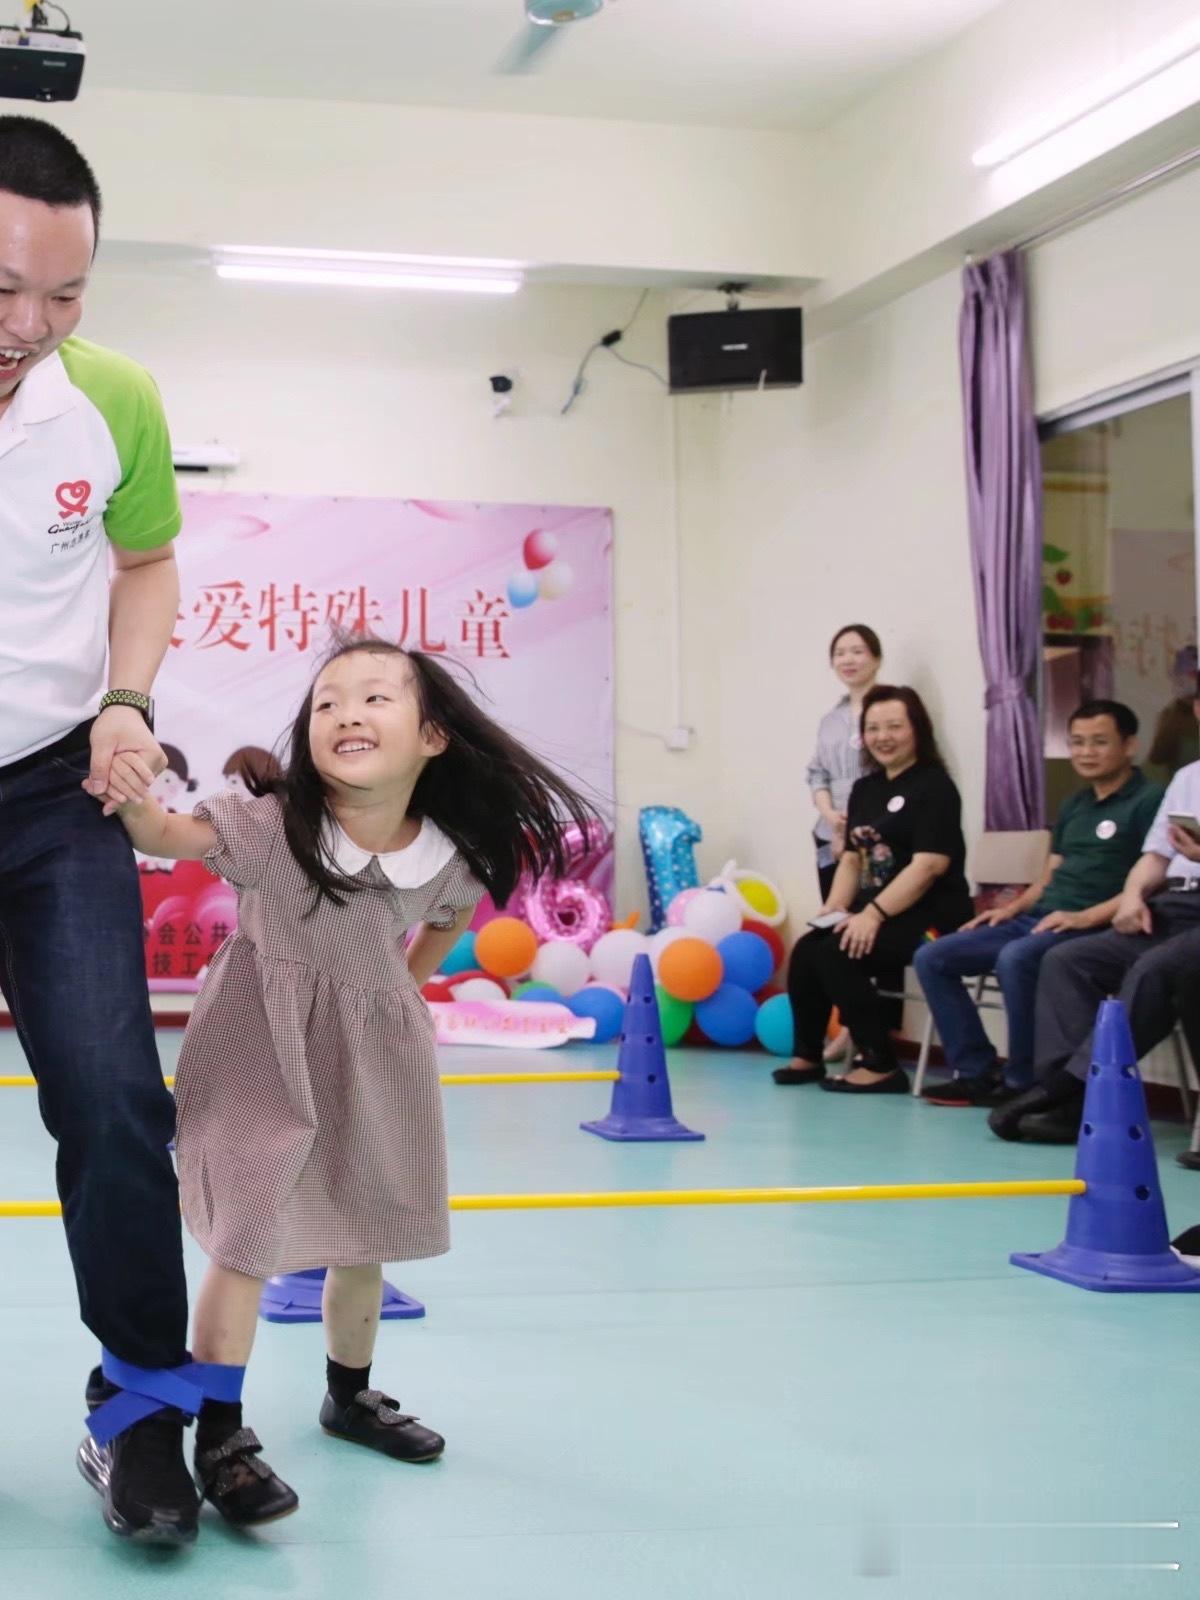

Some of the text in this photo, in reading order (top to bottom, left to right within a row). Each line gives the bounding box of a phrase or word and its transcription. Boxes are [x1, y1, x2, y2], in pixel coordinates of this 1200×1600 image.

[168, 580, 511, 659] 爱特殊儿童
[143, 921, 229, 946] 会公共
